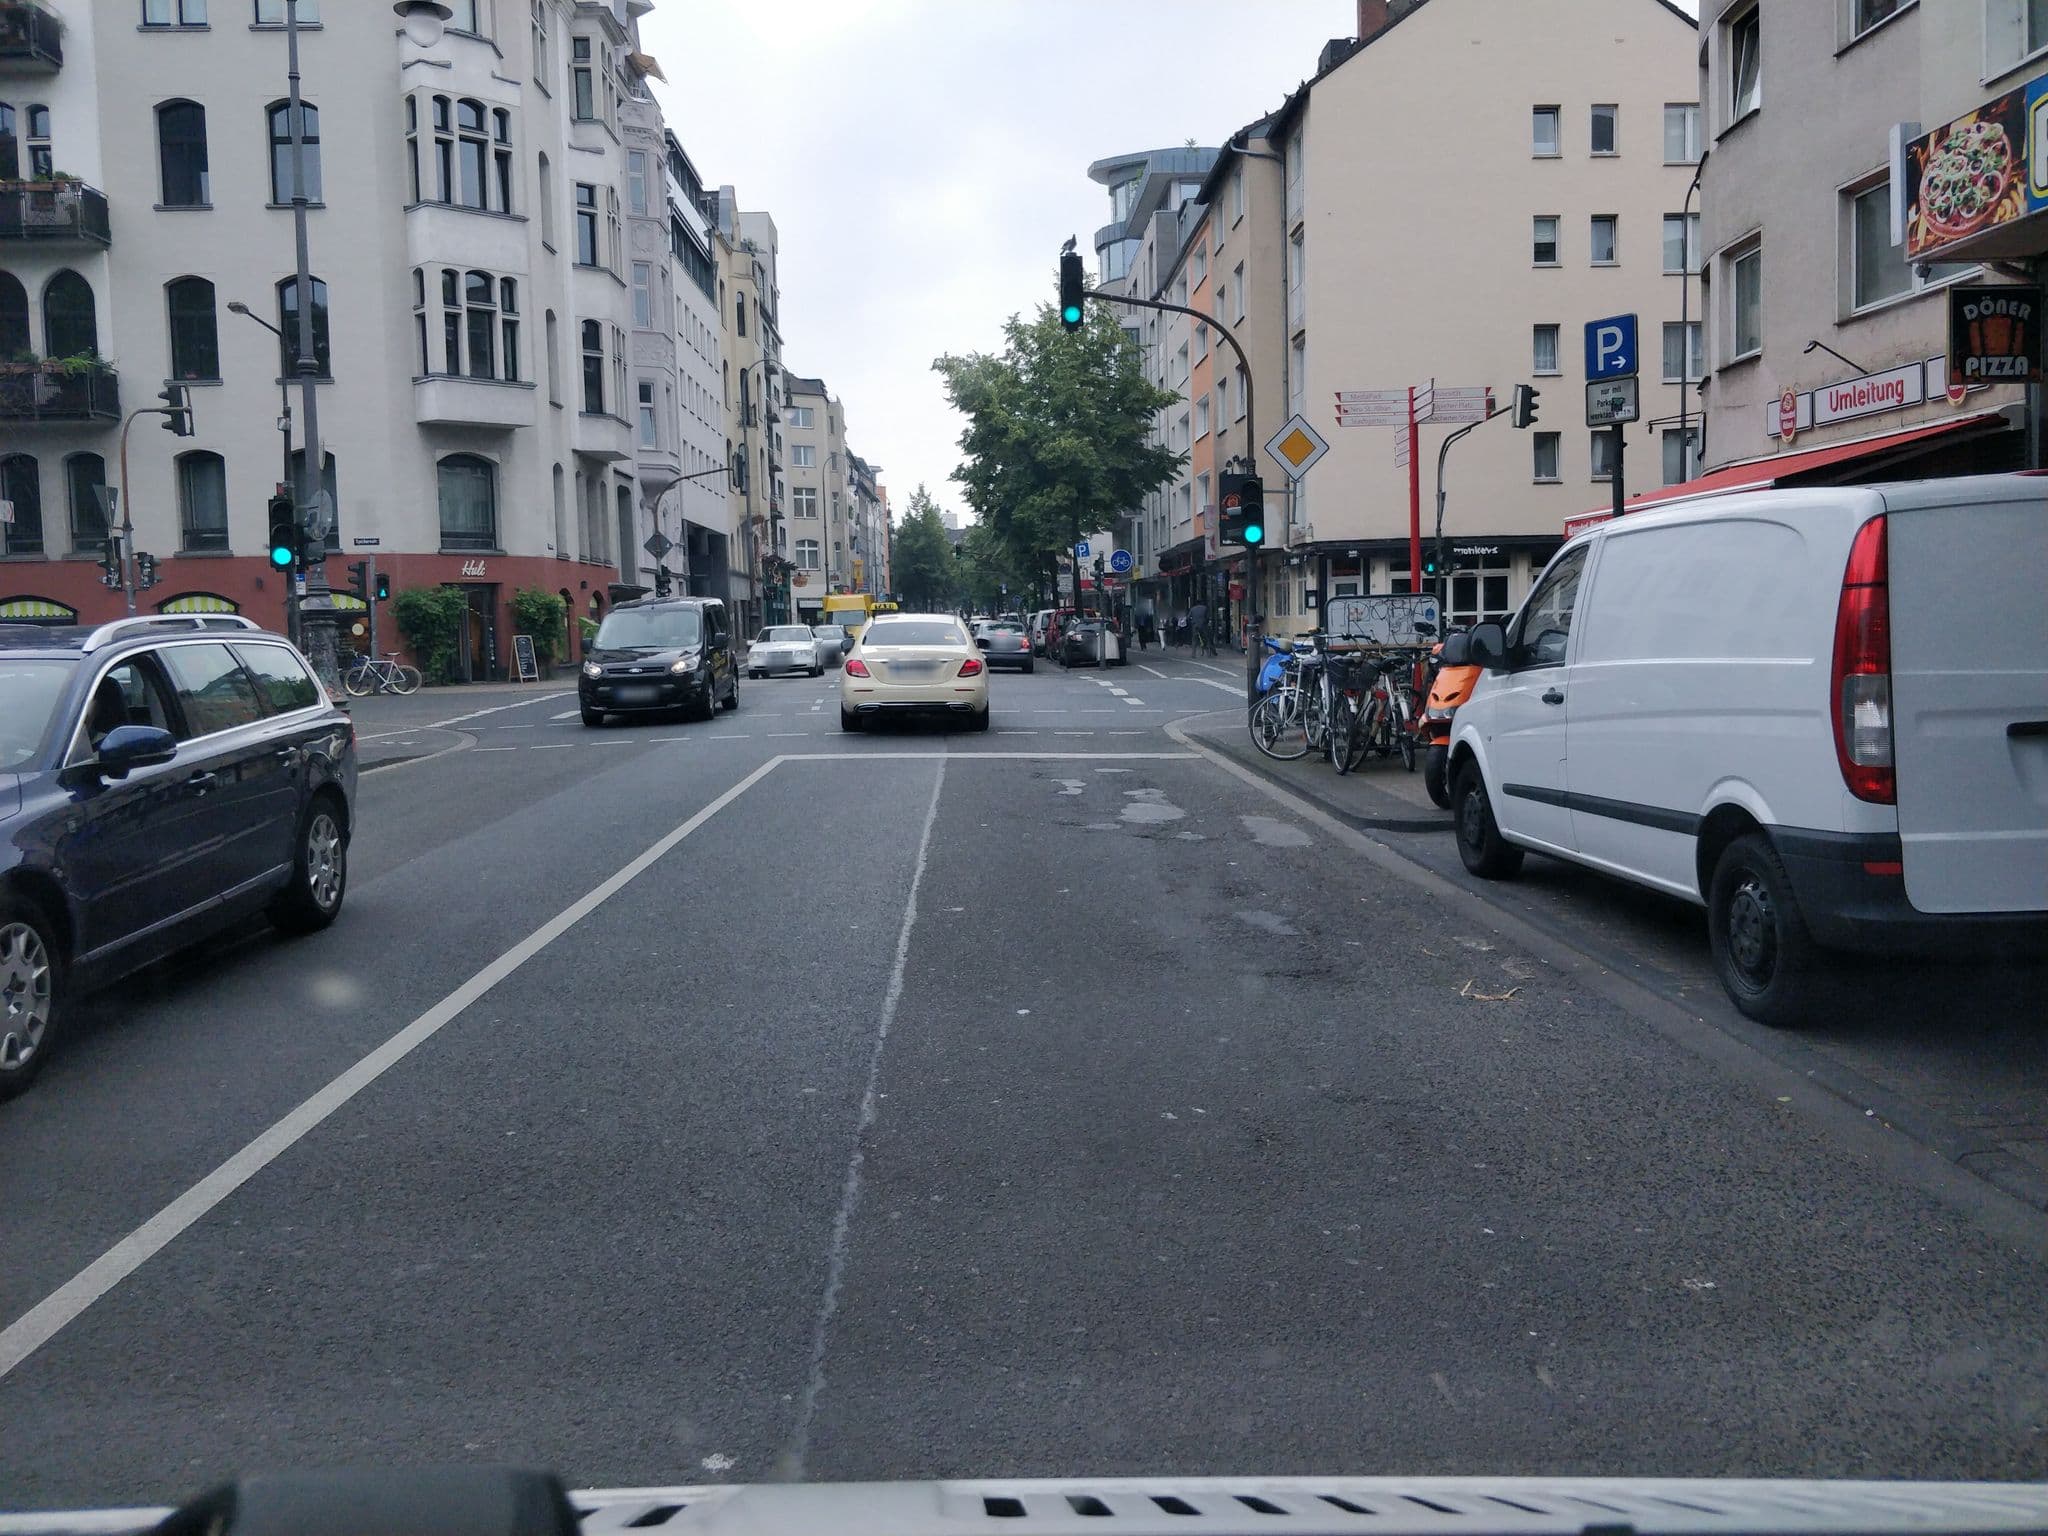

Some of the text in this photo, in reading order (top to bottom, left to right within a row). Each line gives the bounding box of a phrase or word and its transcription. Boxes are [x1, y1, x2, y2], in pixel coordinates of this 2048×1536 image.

[1963, 295, 2031, 321] DÖNER
[1597, 326, 1624, 371] P
[1964, 355, 2029, 376] PIZZA
[1828, 379, 1904, 413] Umleitung
[1078, 545, 1087, 557] P
[874, 602, 895, 610] TAXI
